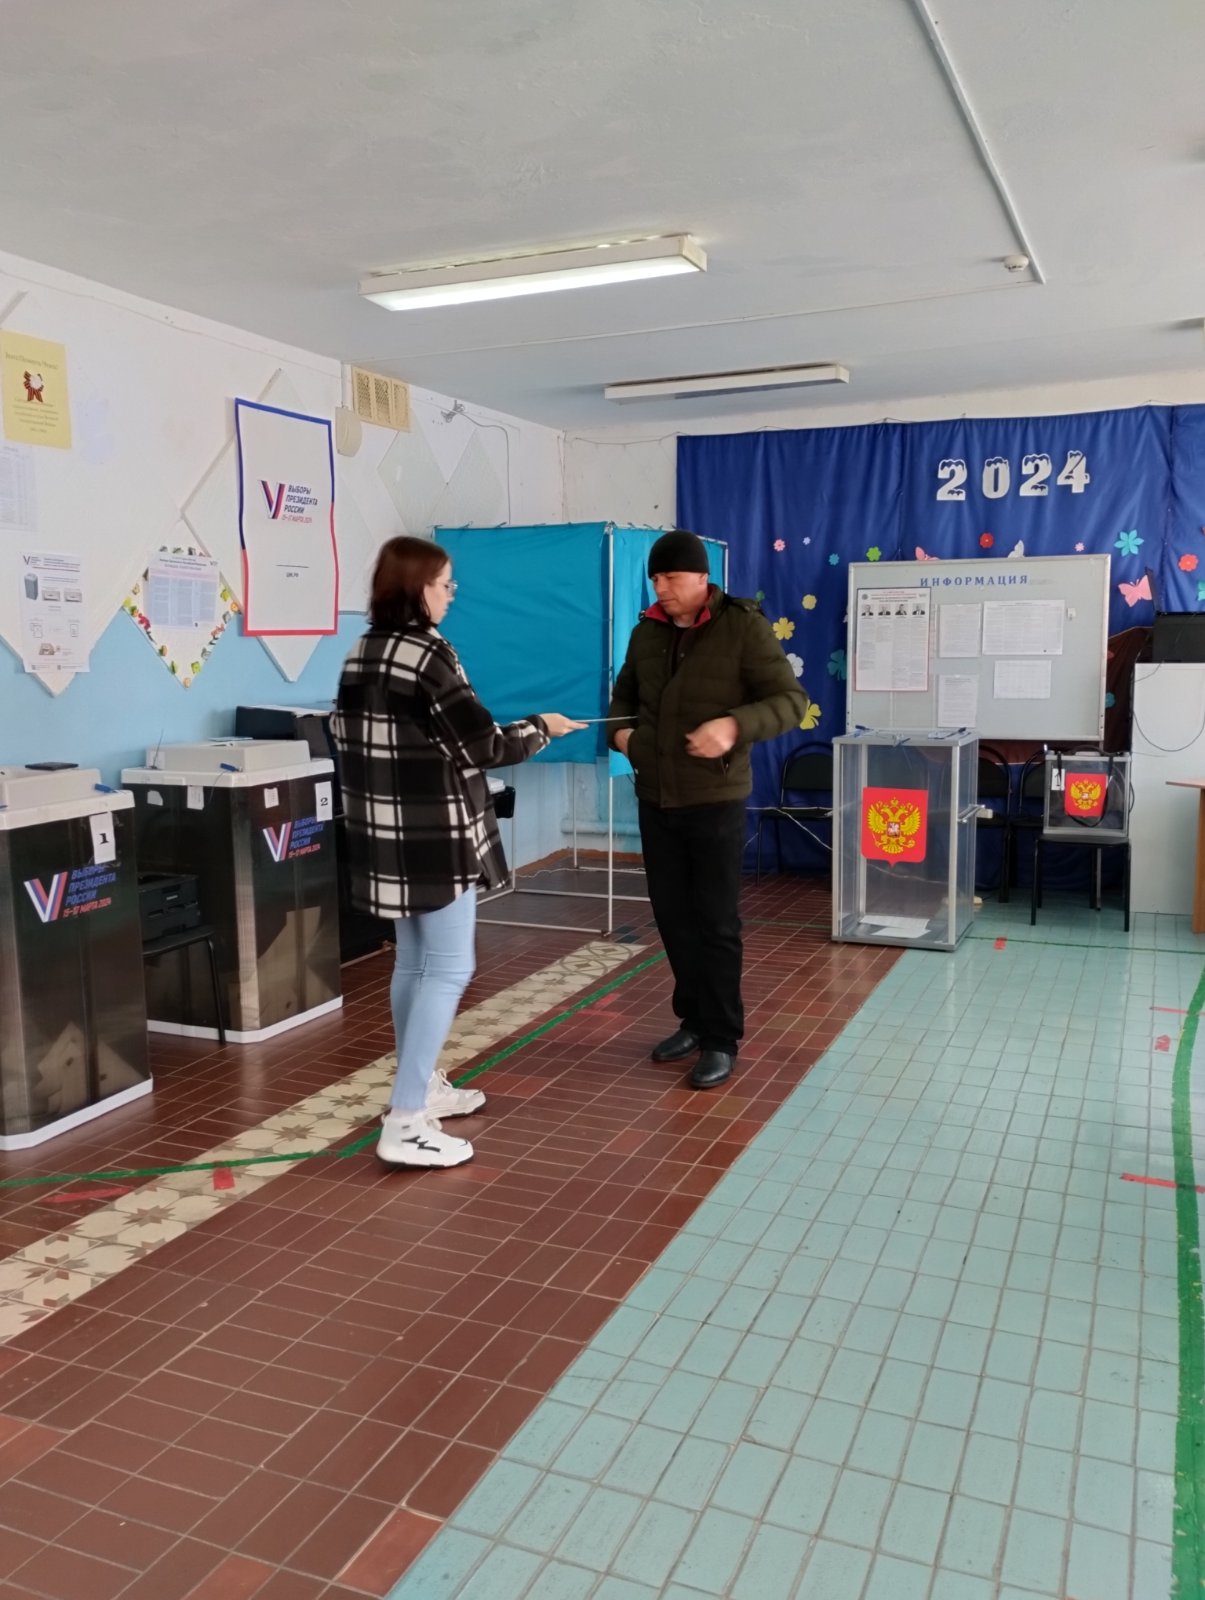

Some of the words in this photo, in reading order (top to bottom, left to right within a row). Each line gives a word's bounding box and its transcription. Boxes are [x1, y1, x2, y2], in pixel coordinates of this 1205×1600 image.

[936, 450, 1090, 500] 2024
[288, 484, 312, 495] ВЫБОРЫ
[286, 494, 318, 506] ПРЕЗИДЕНТА
[284, 504, 305, 514] РОССИИ
[920, 575, 1028, 587] ИНФОРМАЦИЯ
[320, 797, 328, 807] 2
[292, 823, 324, 840] ПРЕЗИДЕНТА
[99, 833, 109, 844] 1
[289, 837, 311, 851] РОССИИ
[69, 872, 116, 893] ПРЕЗИДЕНТА
[65, 889, 97, 906] РОССИИ
